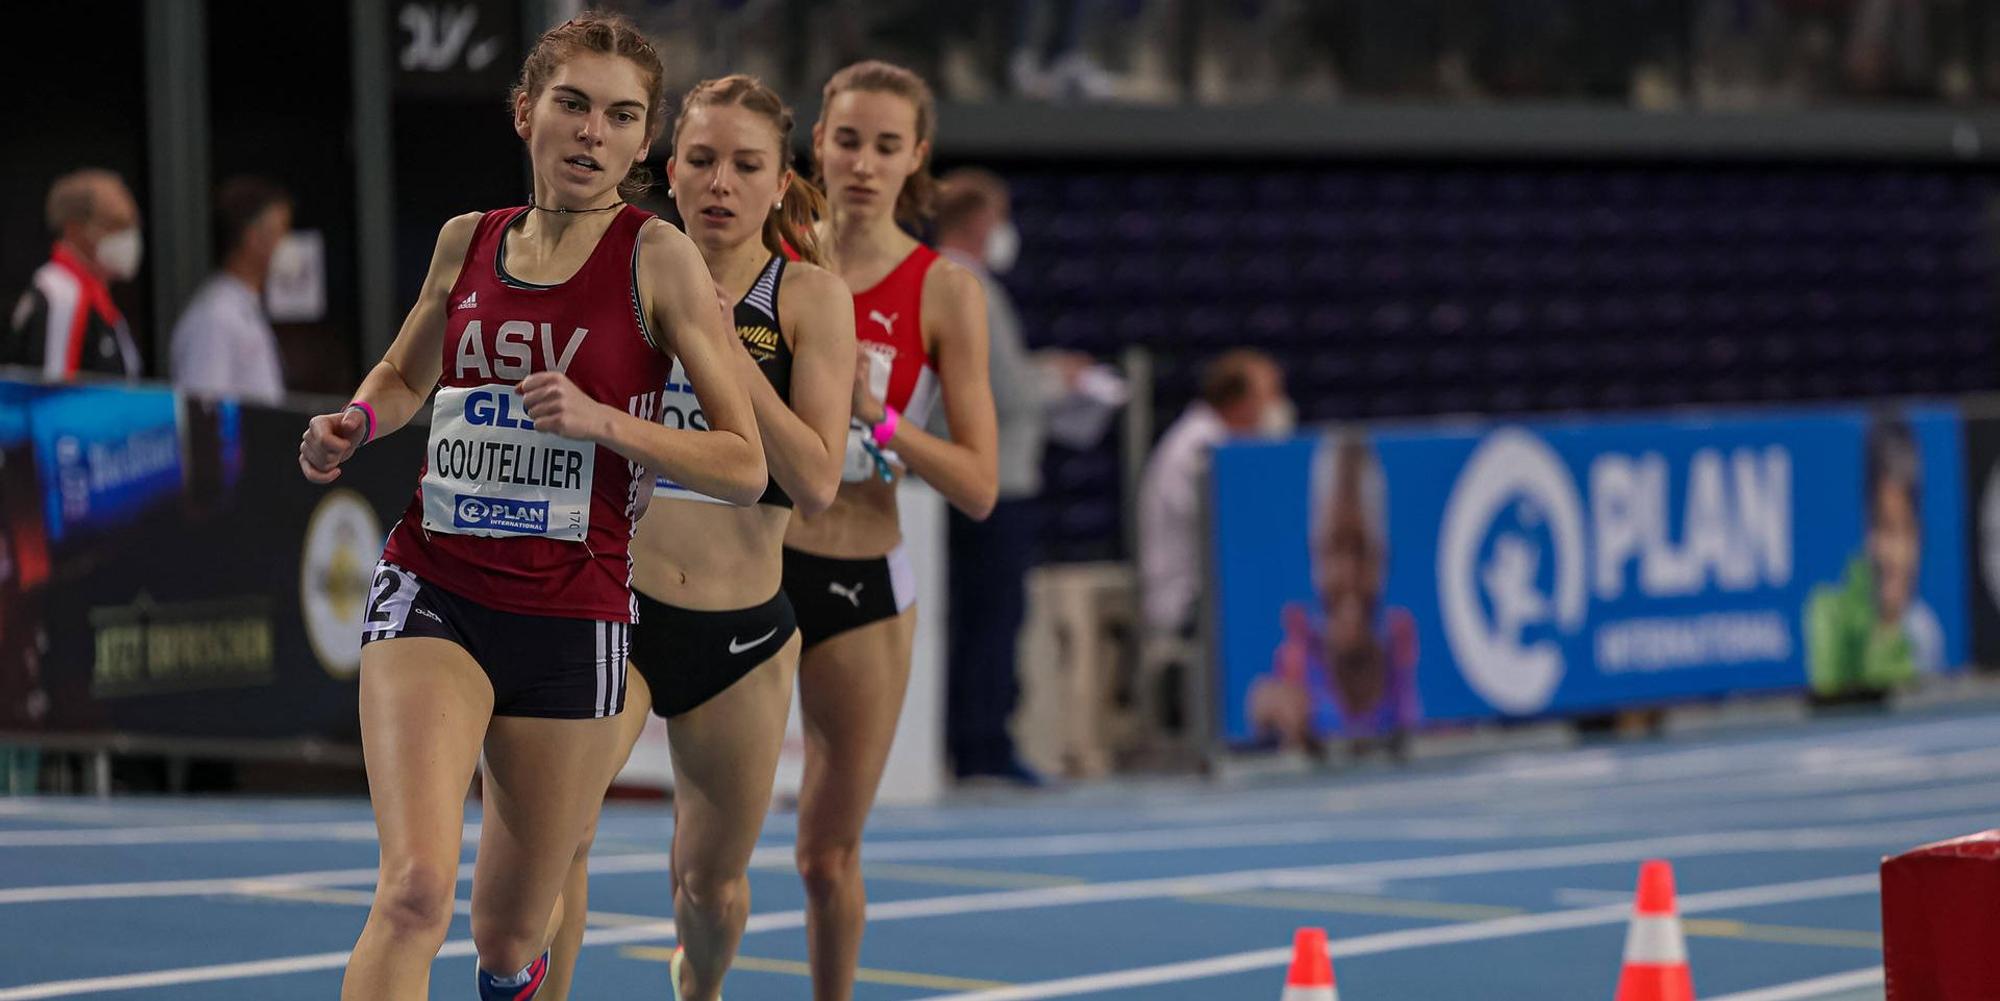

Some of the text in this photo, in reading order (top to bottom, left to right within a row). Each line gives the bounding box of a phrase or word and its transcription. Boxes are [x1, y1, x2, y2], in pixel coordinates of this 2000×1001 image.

[455, 319, 589, 381] ASV
[436, 438, 583, 490] COUTELLIER
[490, 519, 543, 531] INTERNATIONAL
[491, 504, 544, 522] PLAN
[1591, 446, 1793, 600] PLAN
